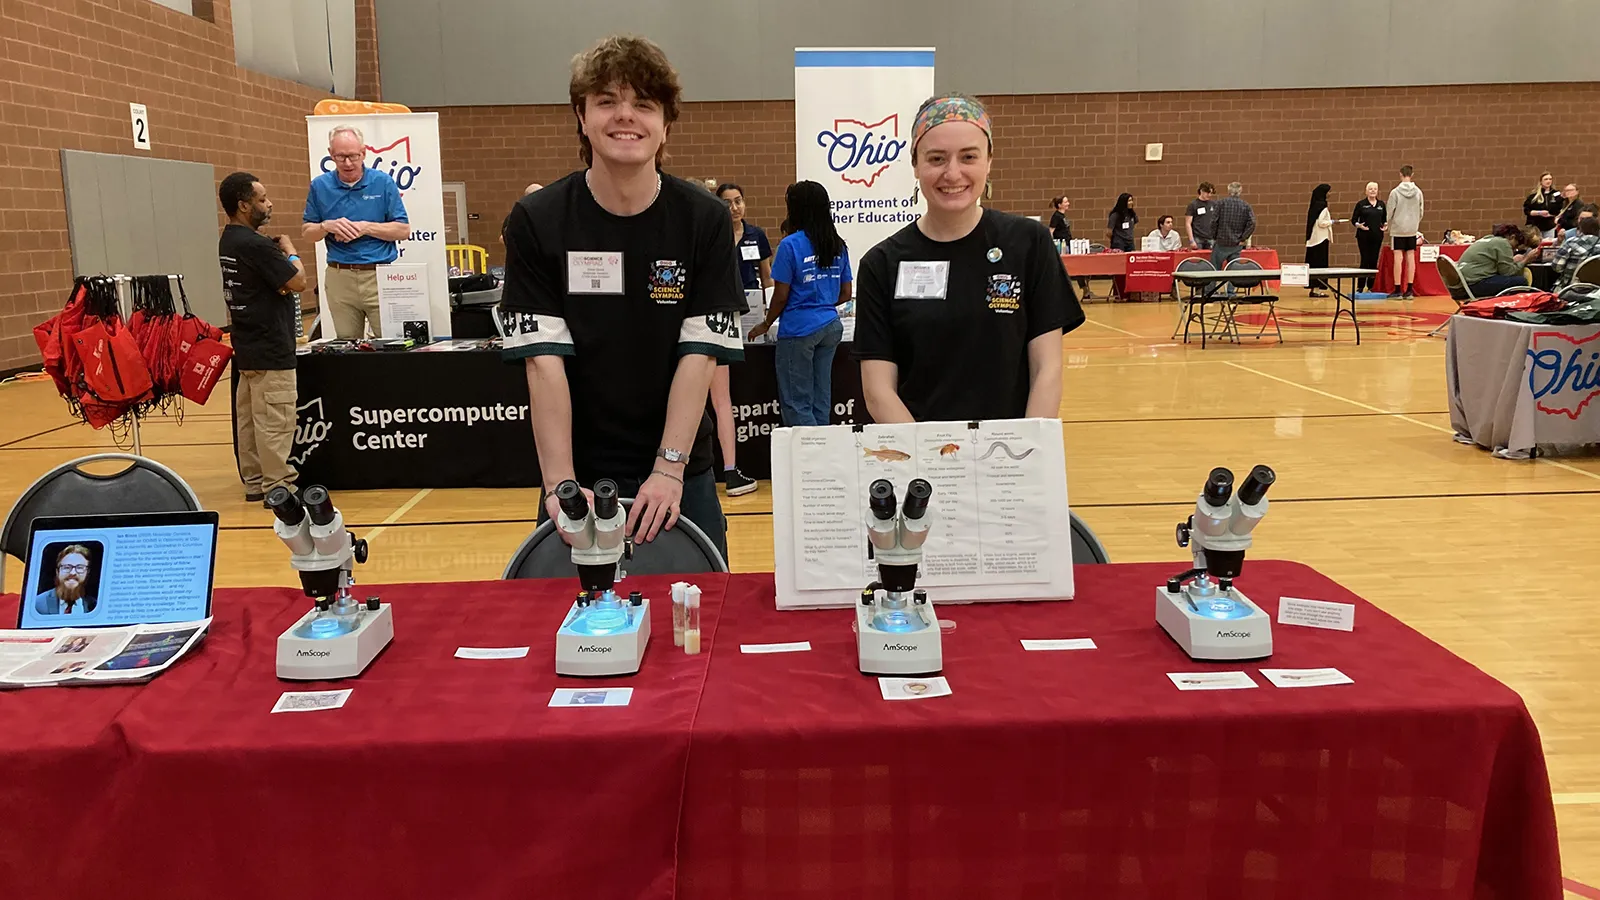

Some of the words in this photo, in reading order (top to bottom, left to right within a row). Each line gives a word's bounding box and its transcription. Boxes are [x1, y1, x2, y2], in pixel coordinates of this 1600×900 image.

[136, 118, 146, 142] 2
[817, 131, 907, 172] Ohio
[830, 197, 898, 210] epartment
[901, 196, 914, 207] of
[832, 213, 854, 223] her
[387, 274, 404, 282] Help
[1527, 348, 1600, 400] Ohi
[834, 399, 854, 415] of
[350, 403, 528, 428] Supercomputer
[737, 421, 780, 442] gher
[352, 431, 427, 450] Center
[1216, 630, 1250, 639] AmScope
[296, 649, 330, 658] AmScope
[577, 645, 612, 654] AmScope
[883, 643, 918, 652] AmScope
